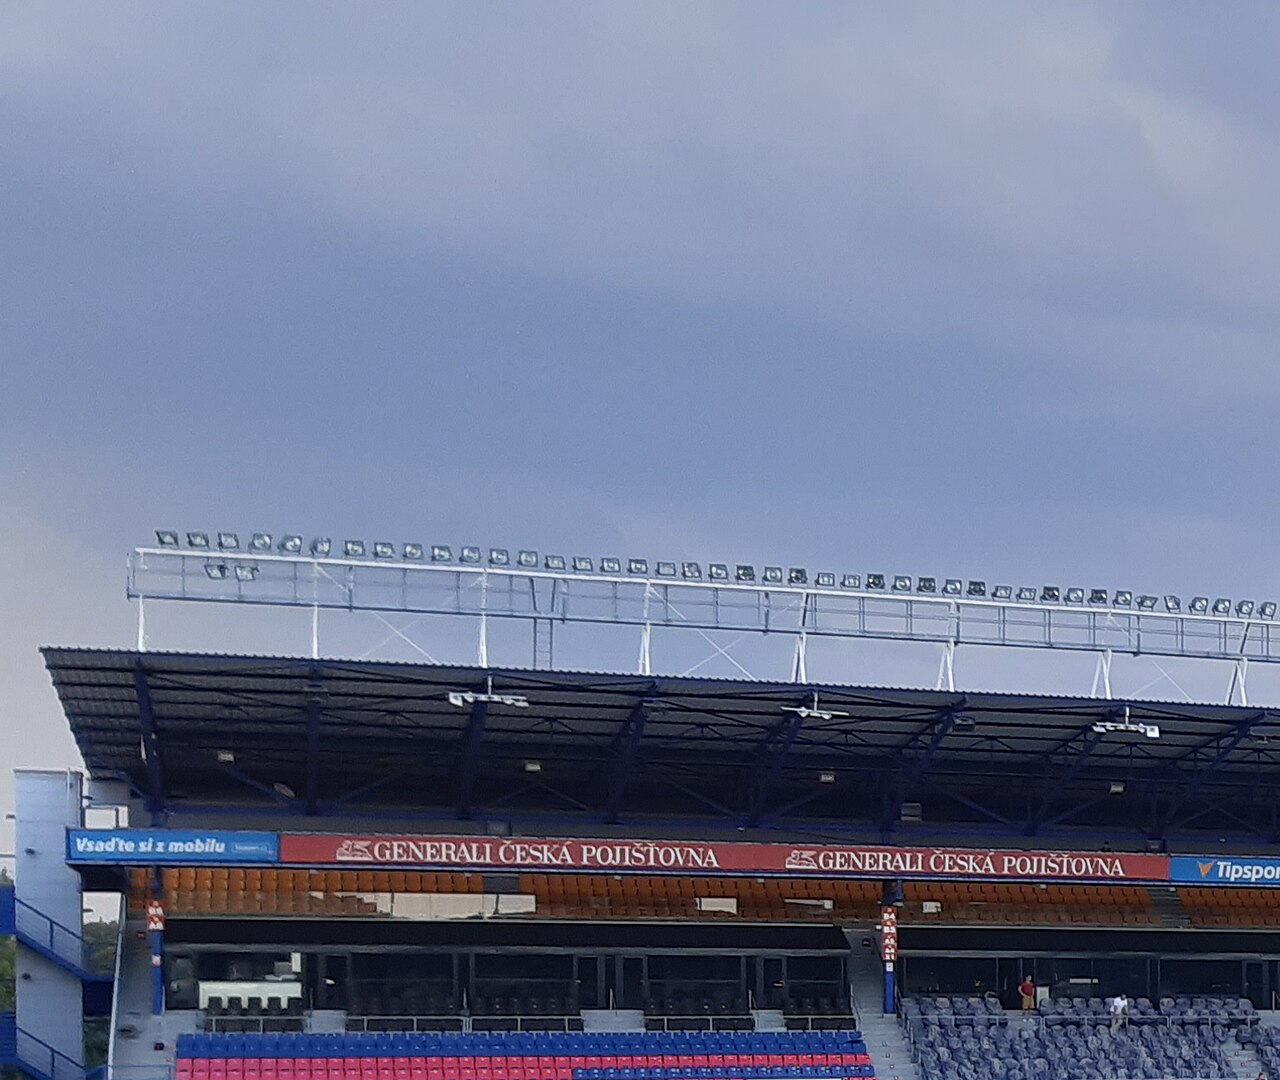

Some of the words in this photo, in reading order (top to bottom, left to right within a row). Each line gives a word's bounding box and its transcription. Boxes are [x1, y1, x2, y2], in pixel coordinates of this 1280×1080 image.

[75, 836, 134, 853] Vsaďte
[138, 837, 154, 853] si
[155, 841, 164, 853] z
[168, 838, 226, 854] mobilu
[373, 841, 493, 864] GENERALI
[498, 840, 574, 866] ČESKÁ
[580, 842, 720, 869] POJIŠŤOVNA
[818, 851, 925, 872] GENERALI
[929, 850, 996, 874] ČESKÁ
[1002, 852, 1126, 877] POJIŠŤOVNA
